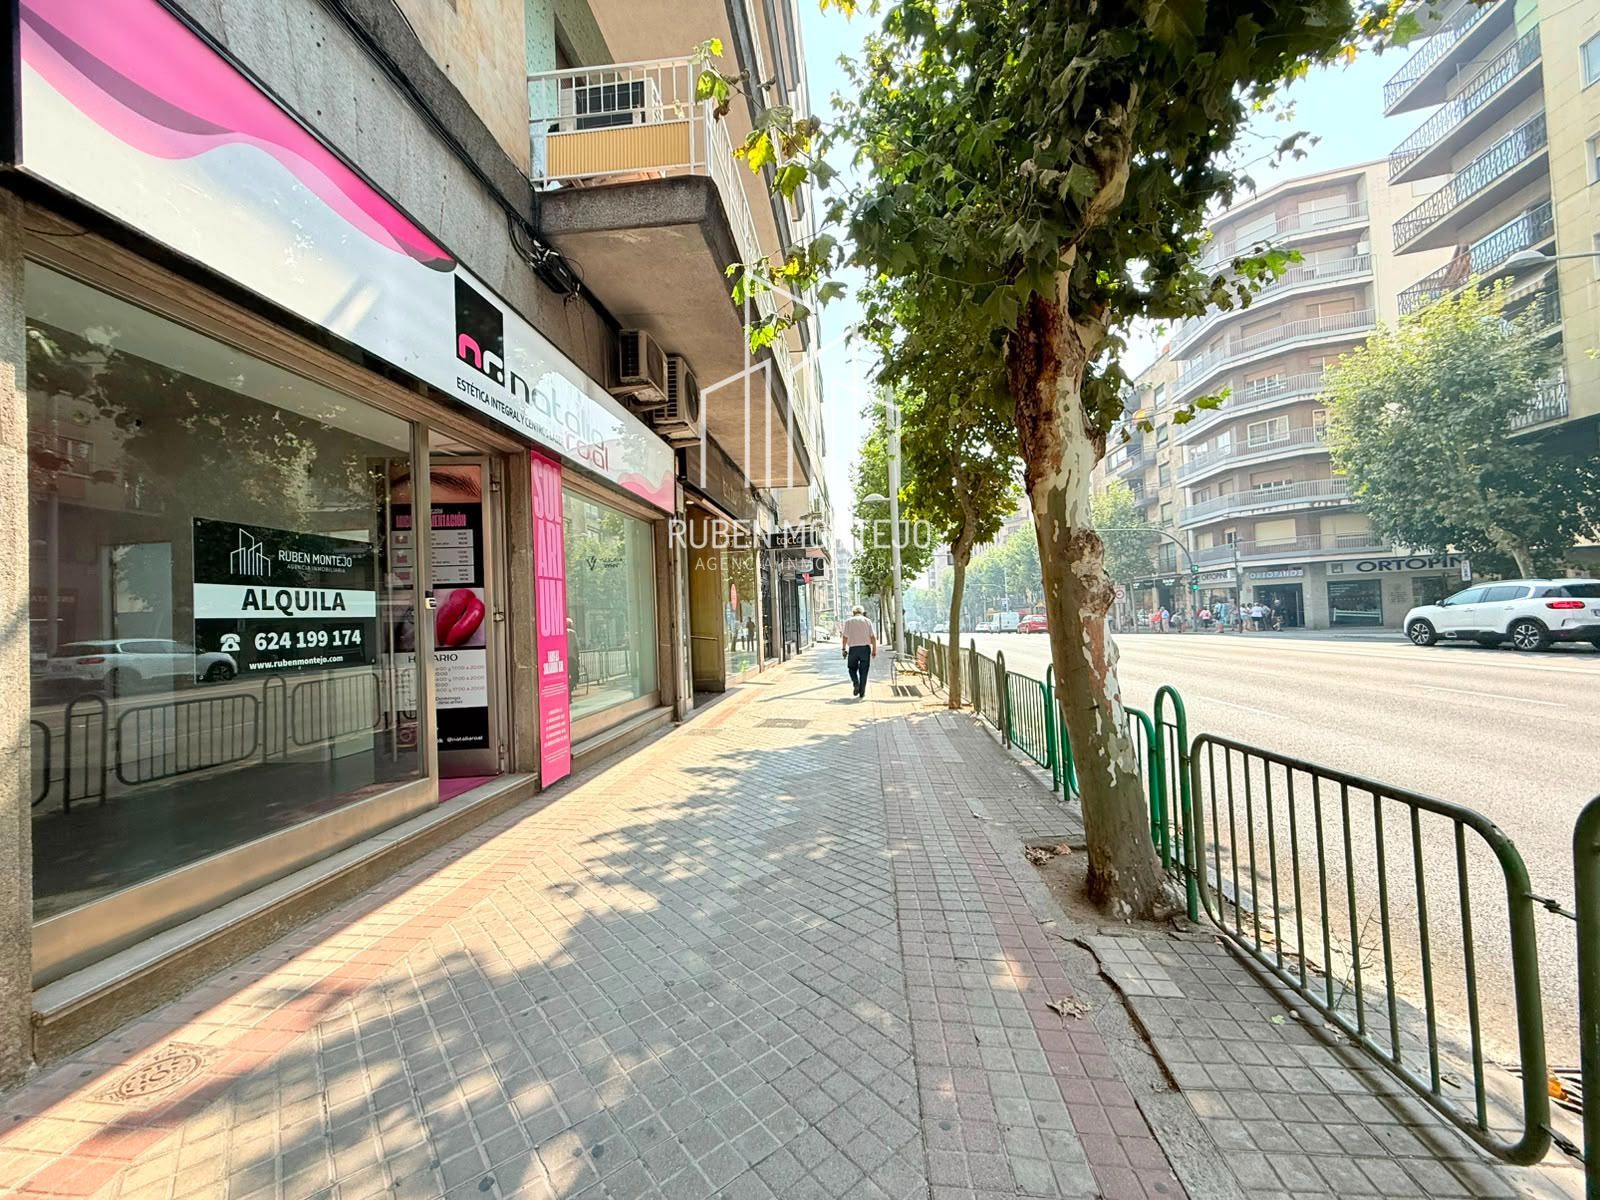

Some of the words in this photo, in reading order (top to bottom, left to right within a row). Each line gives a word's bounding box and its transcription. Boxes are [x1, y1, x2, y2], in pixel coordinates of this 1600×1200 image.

[456, 376, 490, 405] ESTÉTICA
[490, 396, 520, 422] INTEGRAL
[510, 371, 605, 449] natalia
[532, 458, 562, 523] SOL
[278, 550, 310, 564] RUBEN
[312, 554, 353, 568] MONTEJO
[537, 520, 563, 579] ARI
[311, 566, 346, 574] INMOBILIARIA
[241, 588, 346, 616] ALQUILA
[540, 579, 565, 637] UM
[254, 631, 292, 651] 624
[295, 630, 329, 648] 199
[332, 629, 362, 646] 174
[249, 655, 344, 671] www.rubenmontejo.com
[408, 653, 458, 663] HARIO
